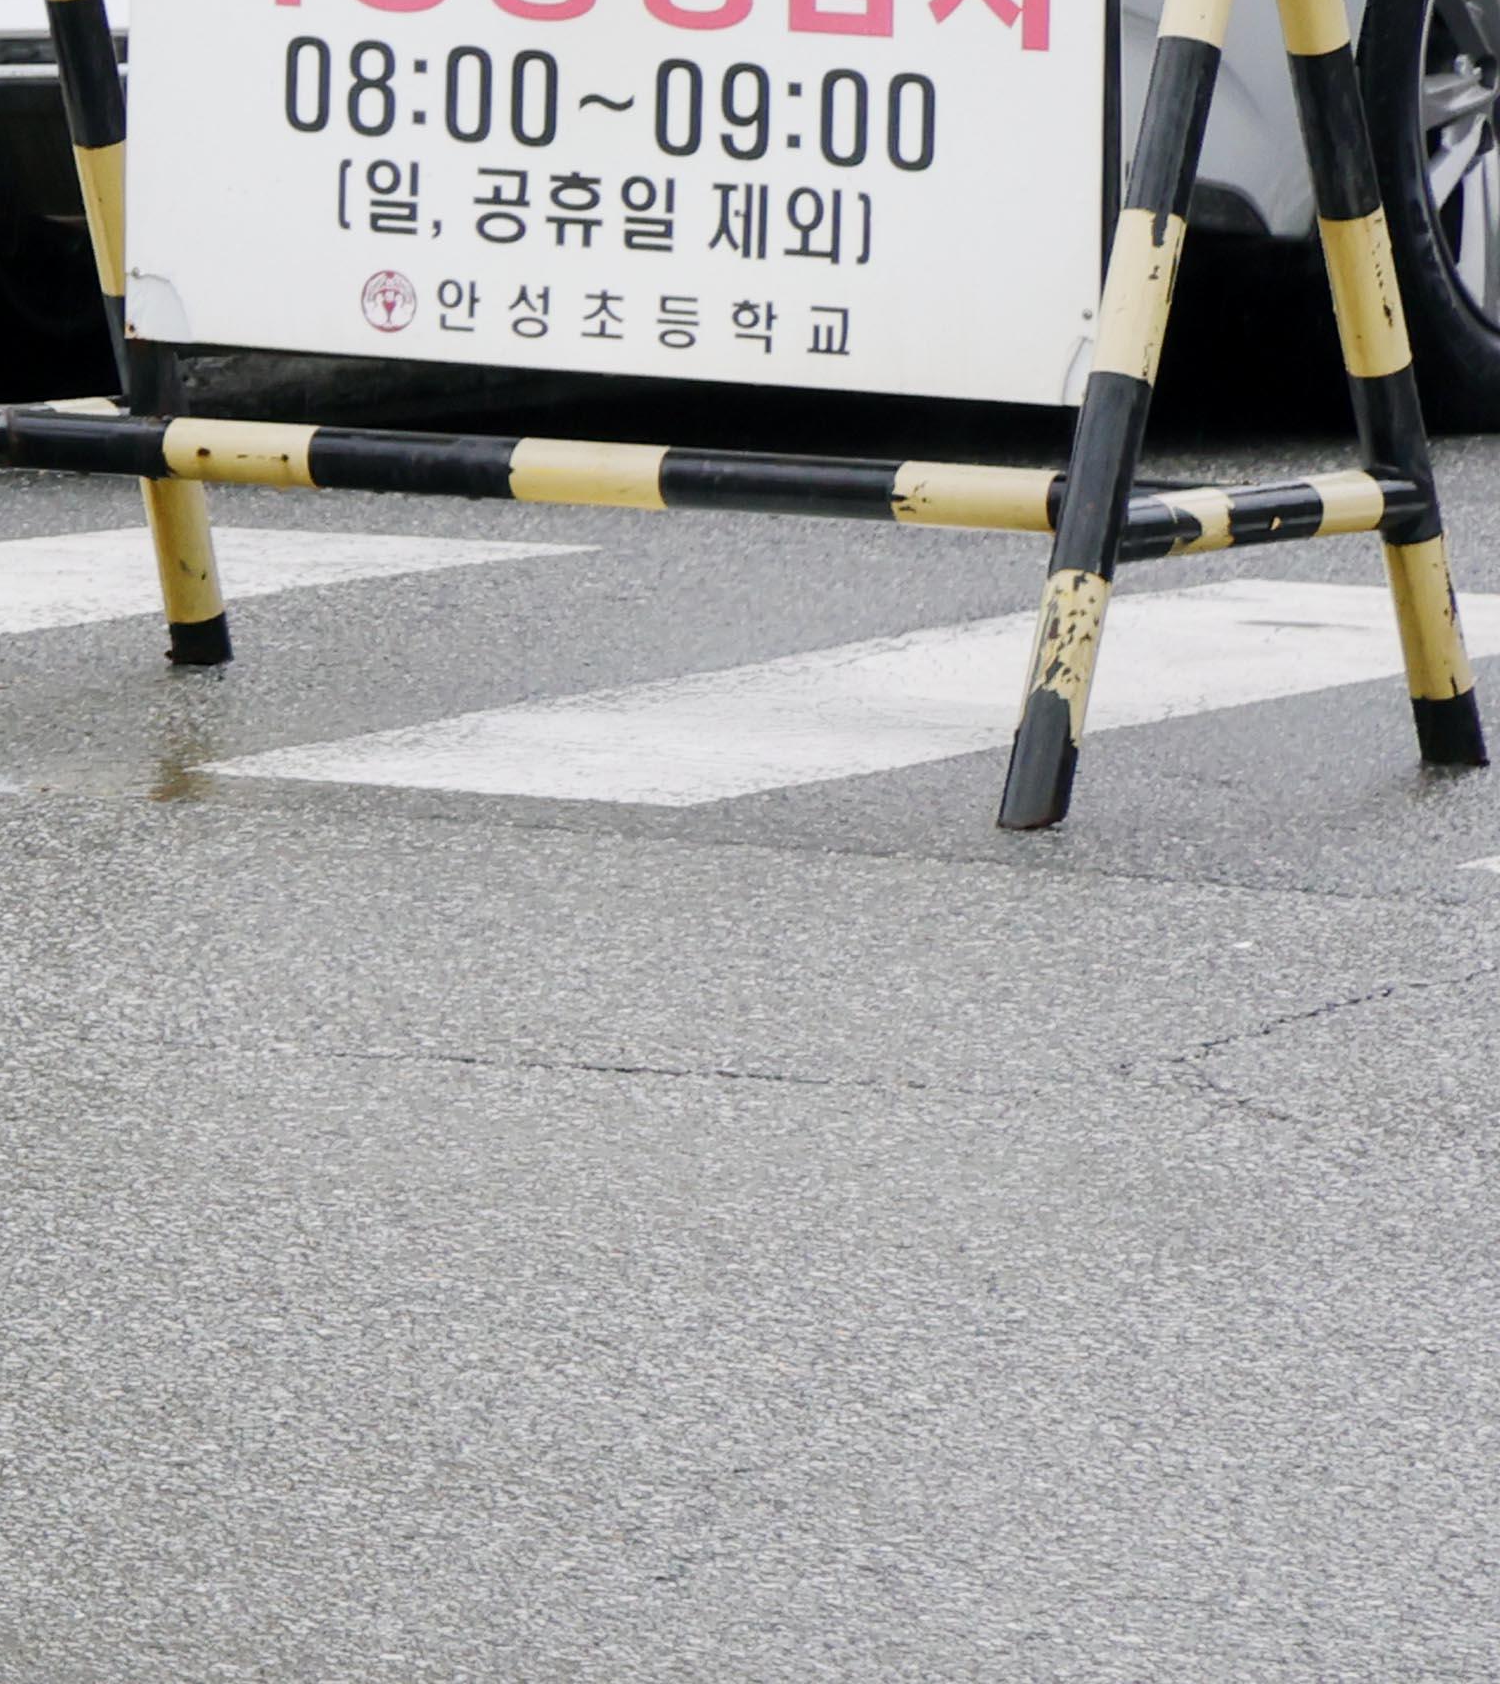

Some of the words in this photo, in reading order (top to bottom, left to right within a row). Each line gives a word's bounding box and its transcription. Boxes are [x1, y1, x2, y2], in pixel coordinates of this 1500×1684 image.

[285, 35, 936, 172] 08:00~09:00
[472, 168, 676, 253] 공휴일
[437, 278, 851, 355] 안성초등학교
